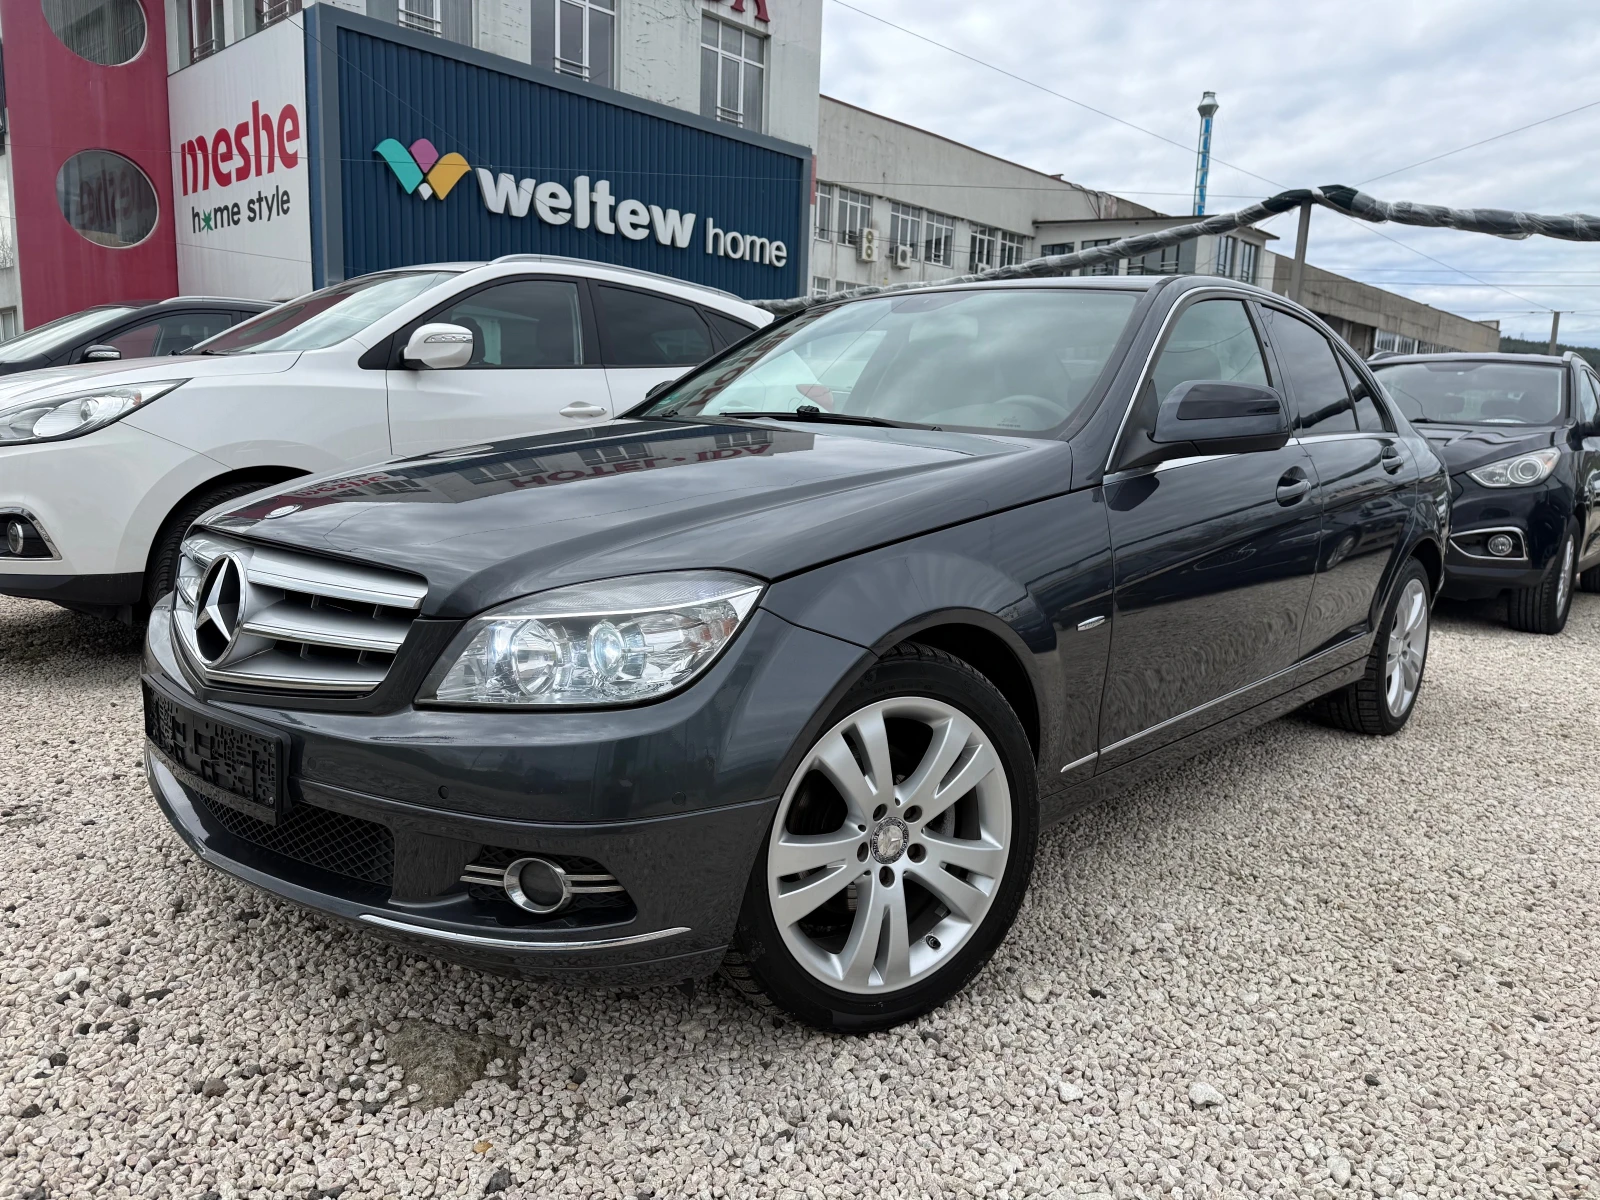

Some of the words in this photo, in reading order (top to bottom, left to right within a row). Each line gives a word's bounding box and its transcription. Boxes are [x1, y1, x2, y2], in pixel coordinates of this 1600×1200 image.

[181, 100, 300, 196] meshe
[247, 185, 291, 222] style
[475, 167, 696, 249] weltew
[705, 217, 788, 268] home
